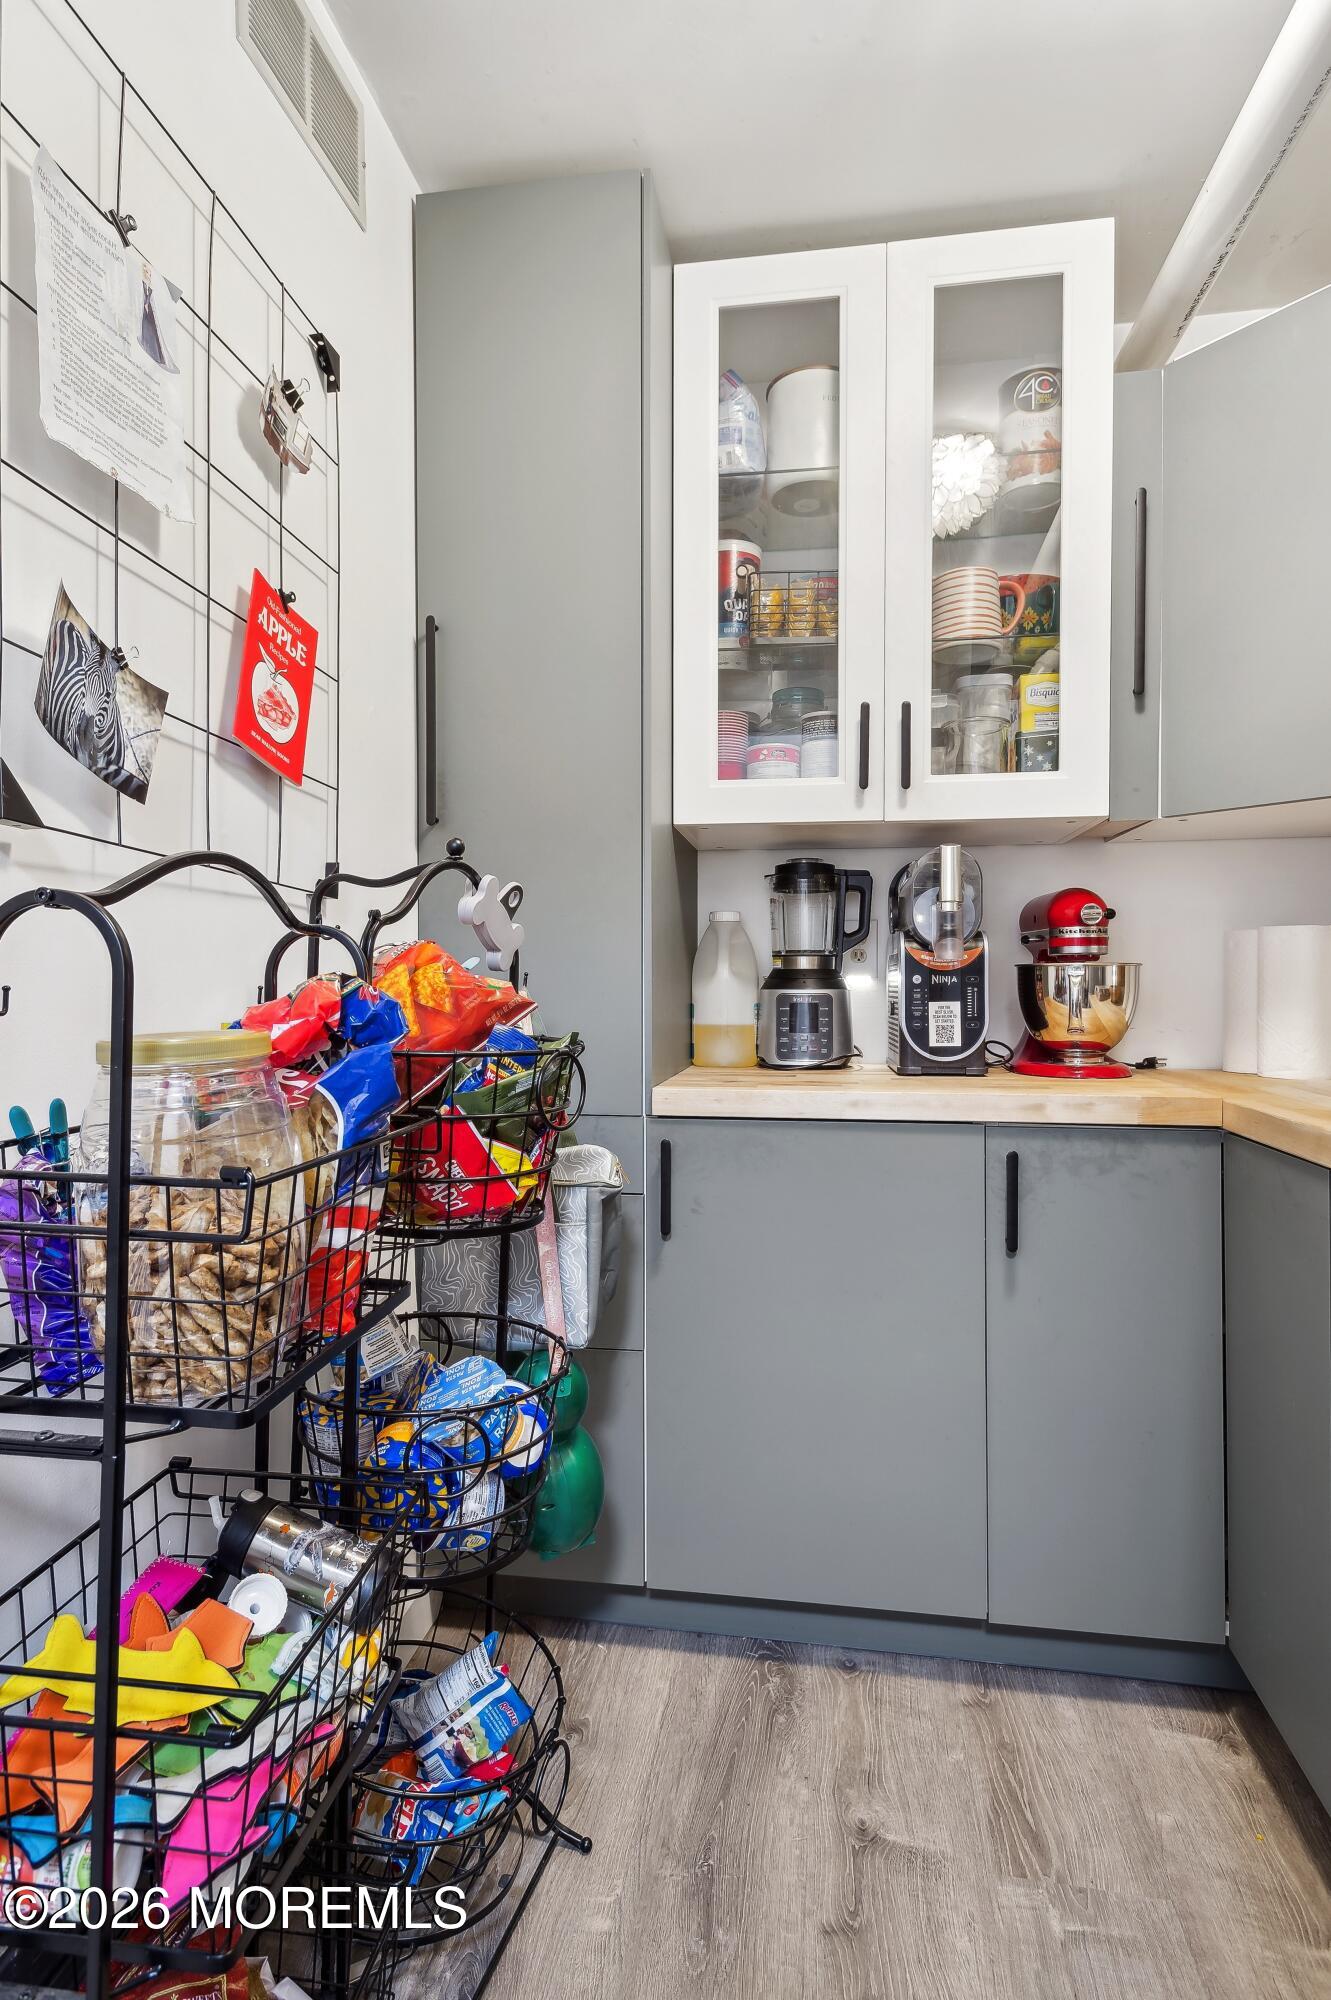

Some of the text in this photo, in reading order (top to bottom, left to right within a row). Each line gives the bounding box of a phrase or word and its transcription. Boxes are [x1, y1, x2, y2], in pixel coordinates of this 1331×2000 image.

[257, 606, 308, 667] APPLE
[270, 642, 289, 666] Recipes
[1029, 687, 1059, 699] Bisquic
[931, 974, 958, 986] NINJA
[484, 1395, 505, 1429] PASA
